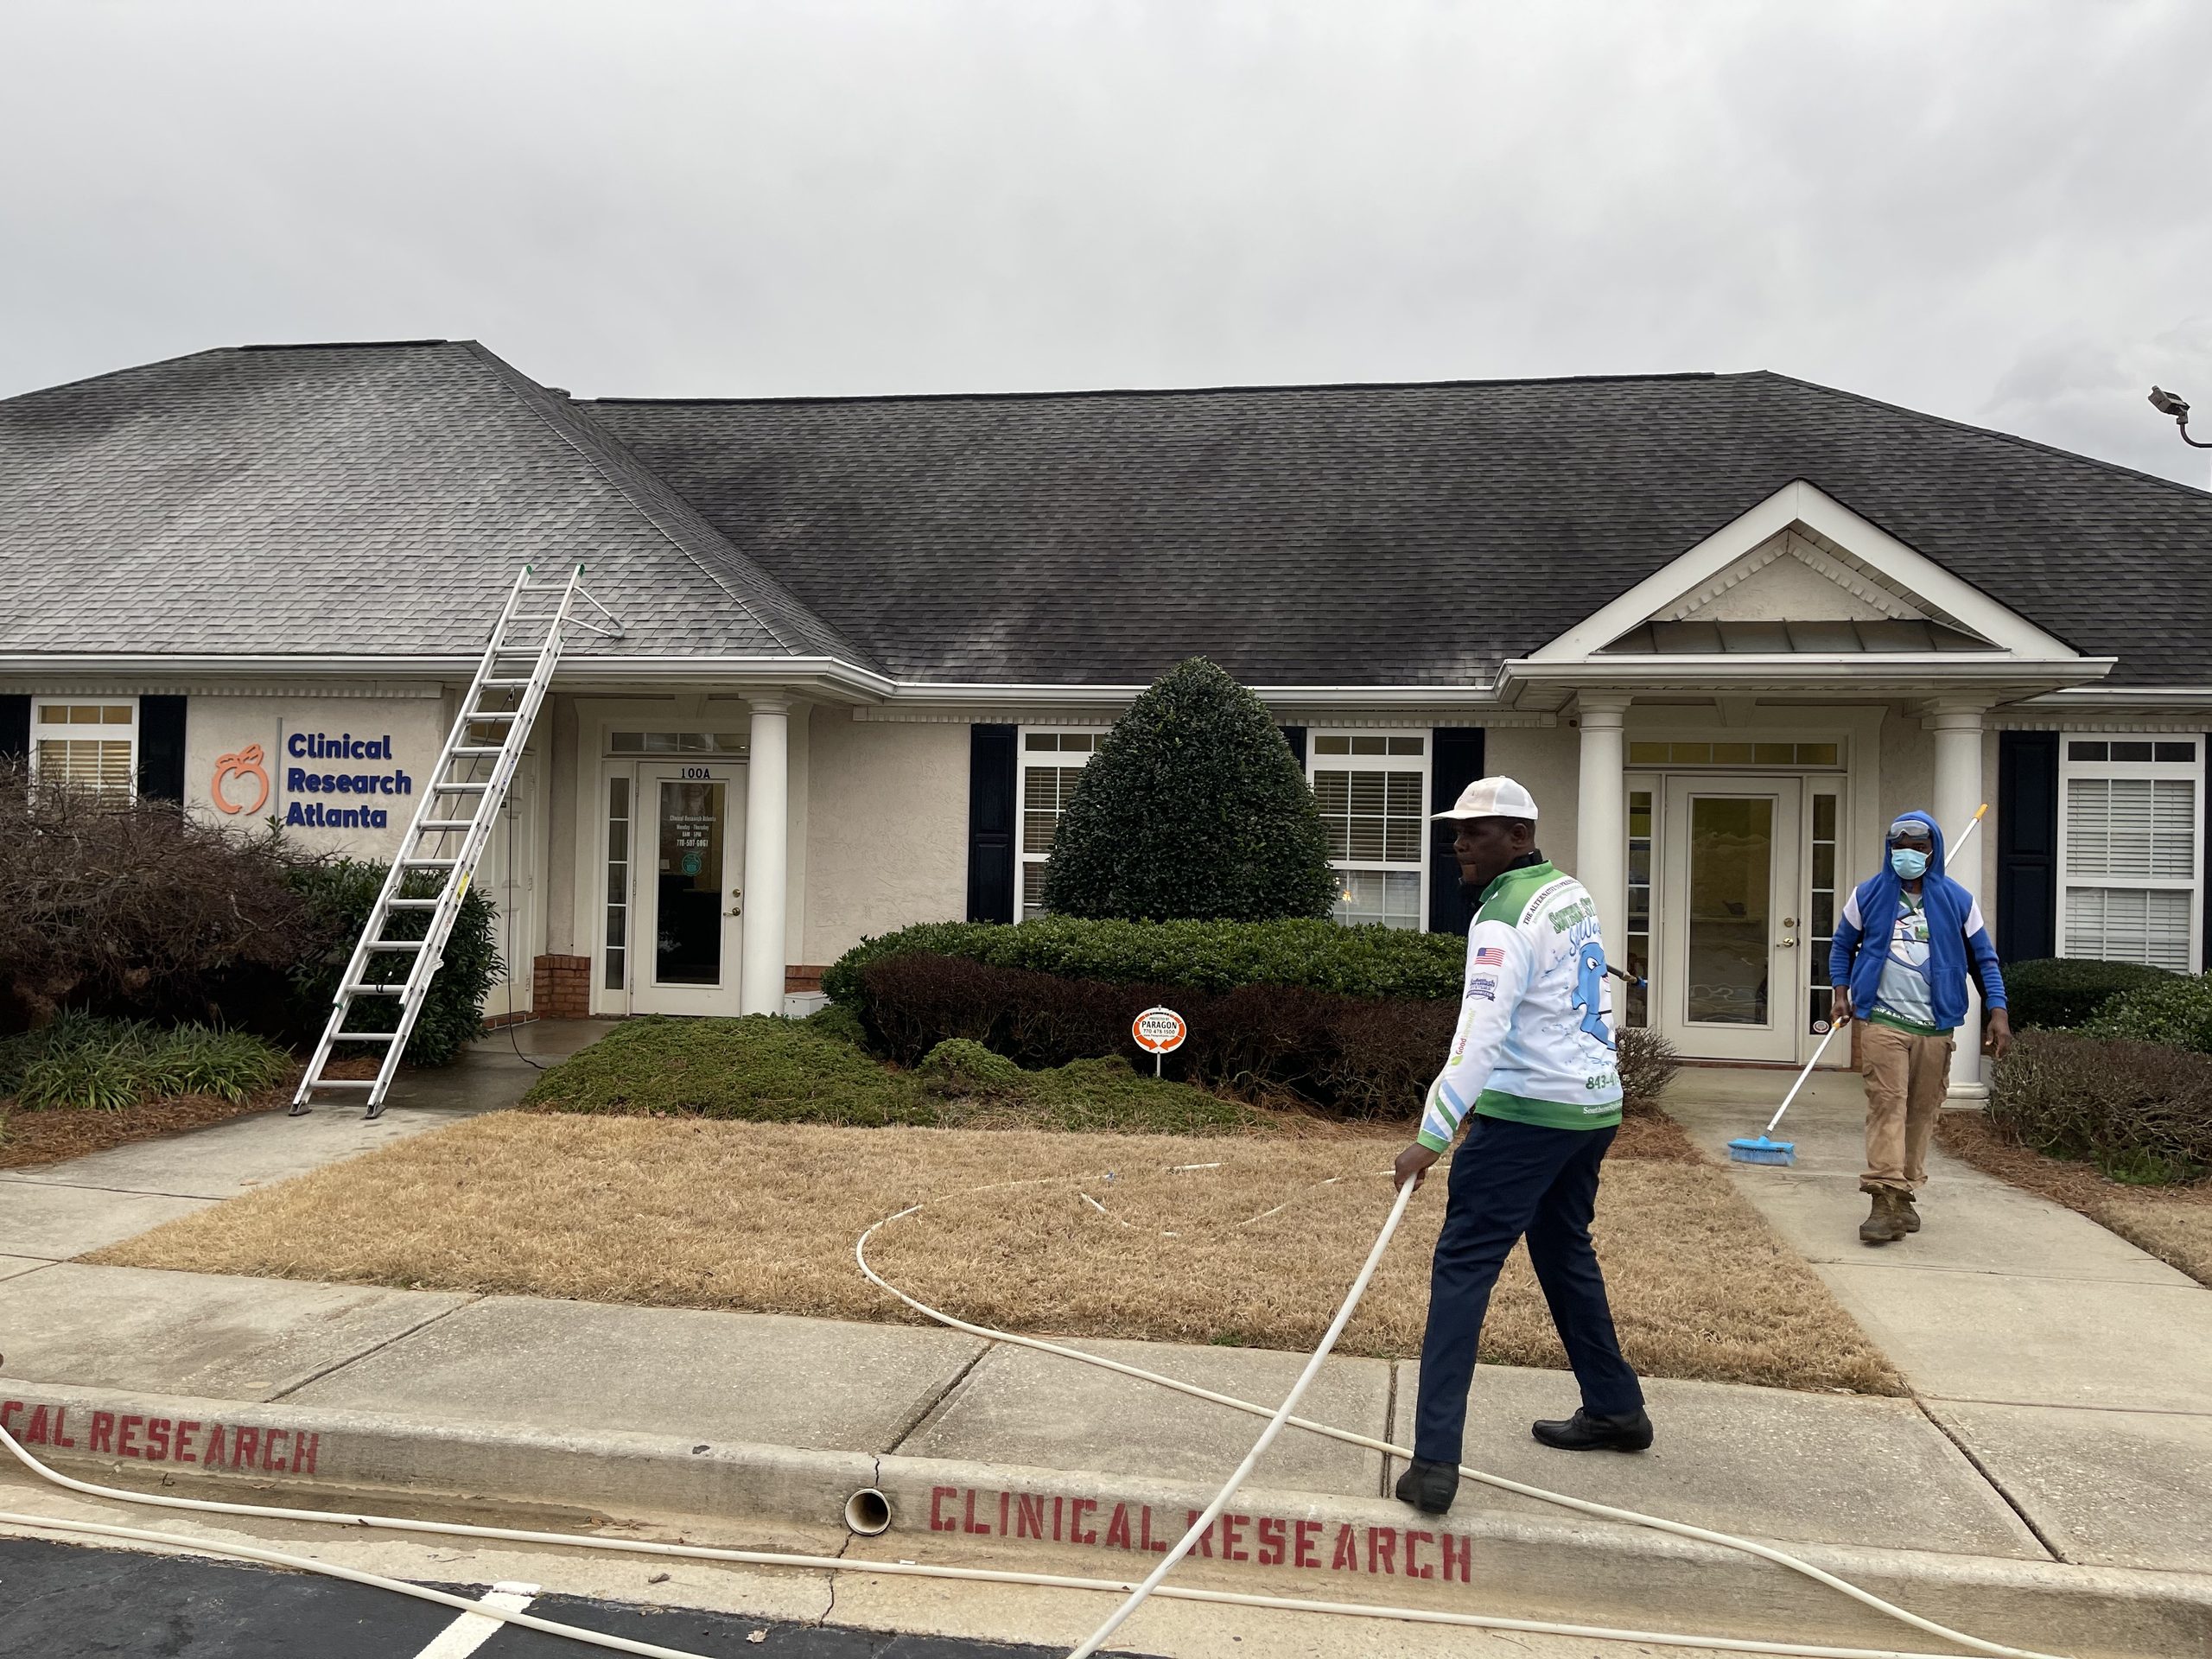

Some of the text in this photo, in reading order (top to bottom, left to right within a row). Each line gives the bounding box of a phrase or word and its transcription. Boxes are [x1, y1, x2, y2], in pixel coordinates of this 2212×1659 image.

[288, 733, 392, 760] Clinical
[287, 767, 411, 794] Research
[682, 768, 710, 779] 100A
[286, 802, 387, 829] Atlanta
[1141, 1020, 1178, 1029] PARAGON
[90, 1410, 320, 1474] RESEARCH
[930, 1486, 1471, 1583] CLINICAL RESEARCH
